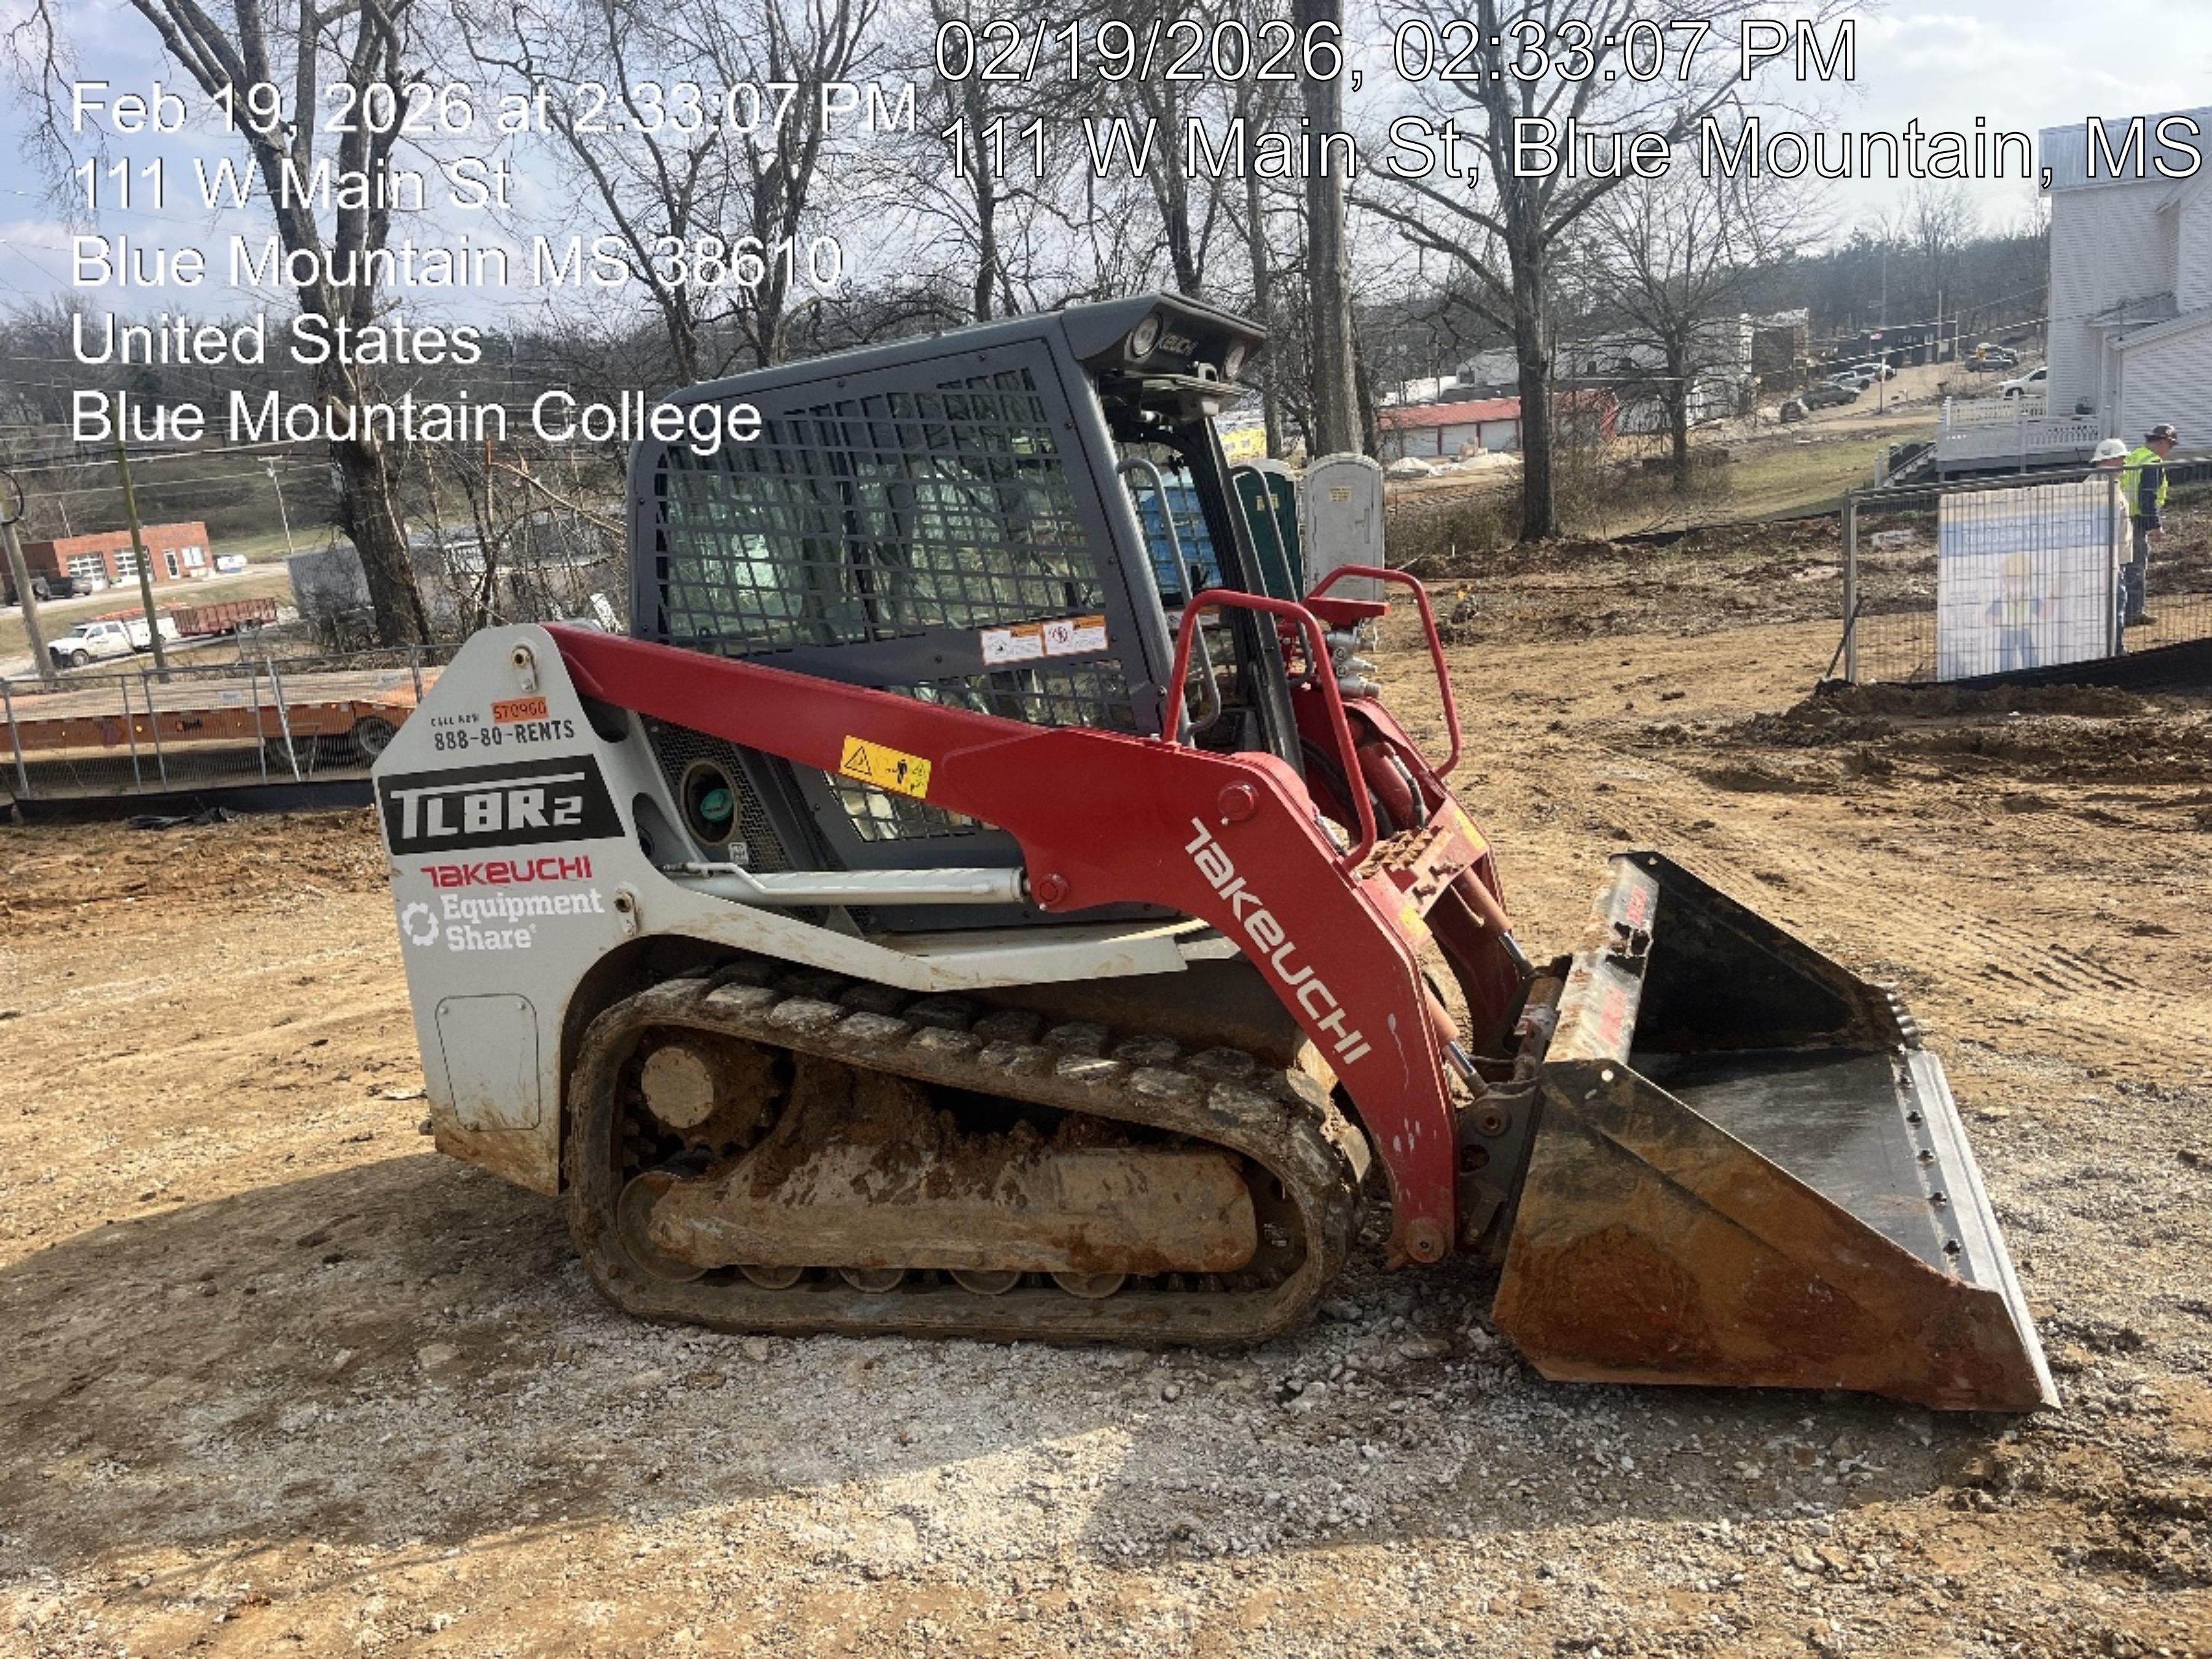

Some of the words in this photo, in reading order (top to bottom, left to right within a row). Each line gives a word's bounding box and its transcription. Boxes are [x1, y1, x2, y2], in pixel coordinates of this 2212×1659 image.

[434, 719, 575, 751] 888-80-RENTS
[420, 855, 593, 888] TAKEUCHI
[440, 888, 605, 924] Equipment
[1184, 817, 1372, 1065] TAKEUCHI
